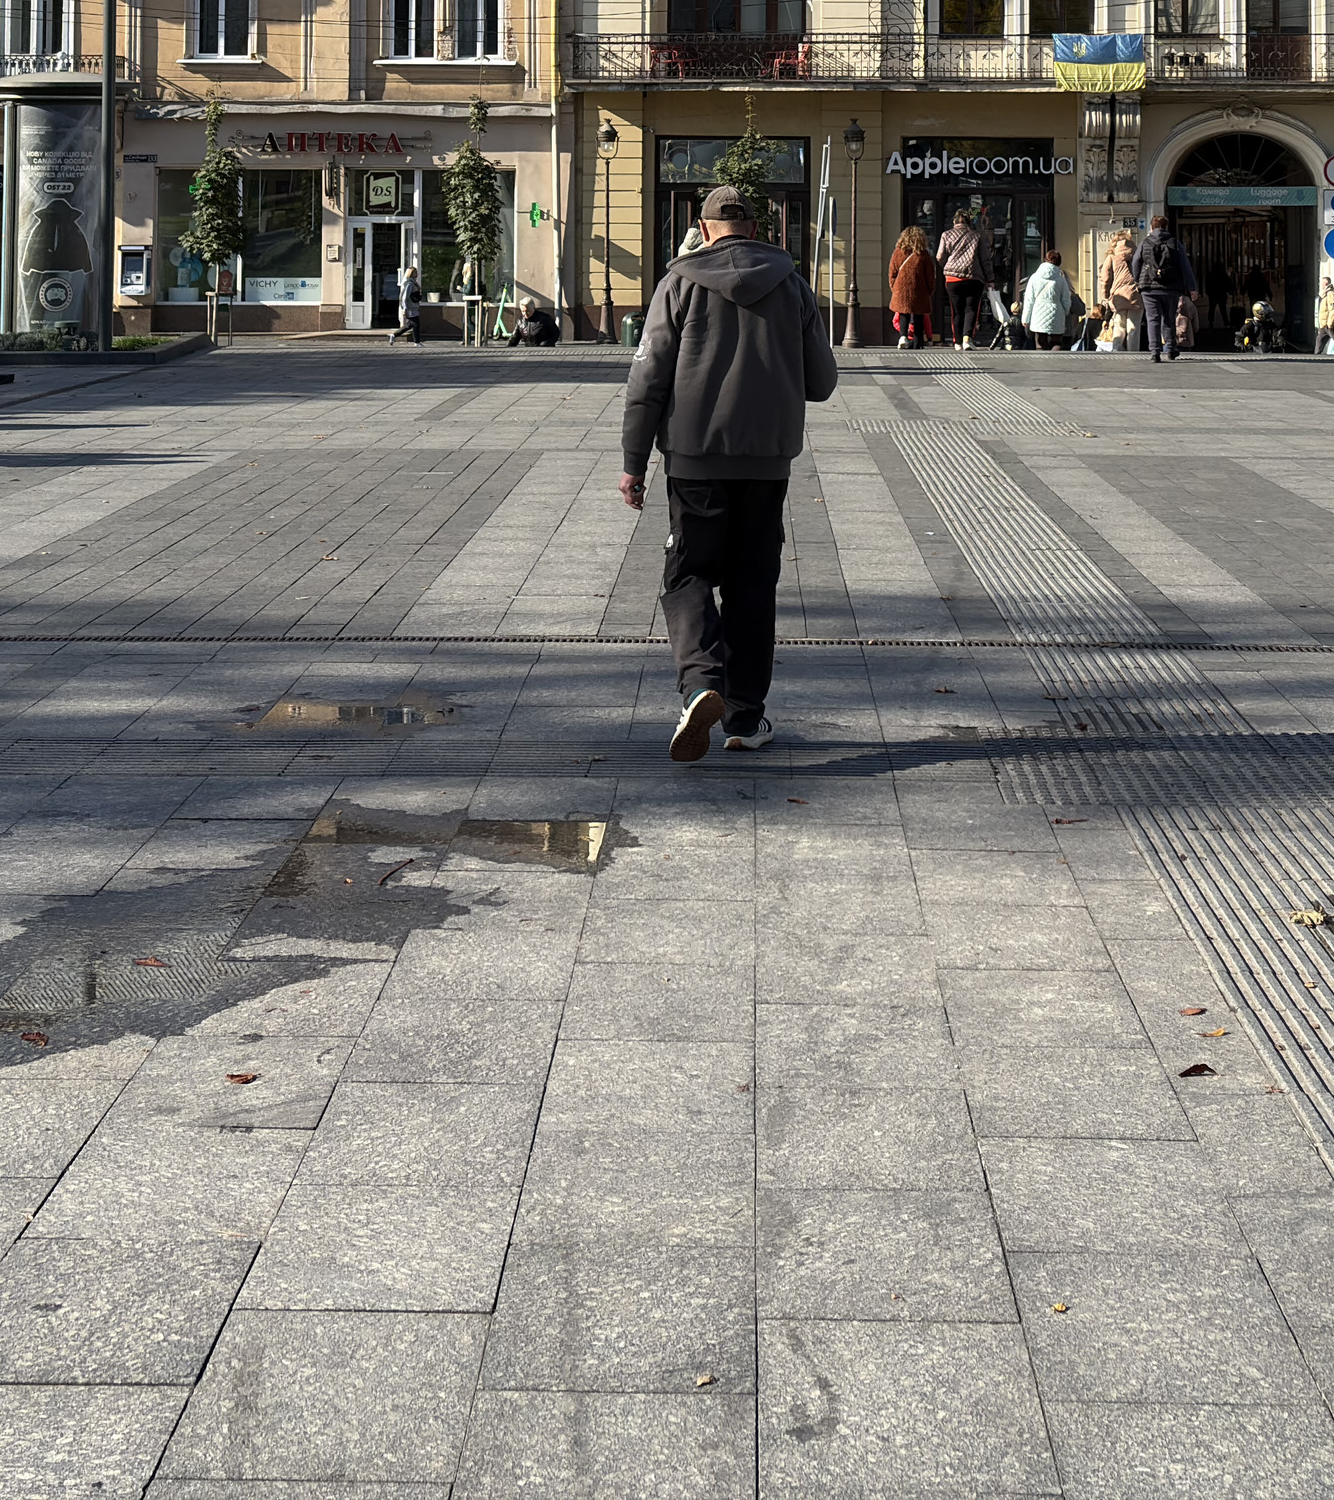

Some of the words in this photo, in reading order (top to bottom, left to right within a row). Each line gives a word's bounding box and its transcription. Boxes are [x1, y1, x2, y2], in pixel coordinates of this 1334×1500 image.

[259, 131, 406, 154] АПТЕКА
[885, 150, 1074, 179] Appleroom.ua
[1250, 187, 1288, 197] Luggage
[1124, 218, 1136, 227] 35
[249, 280, 278, 288] VICHY
